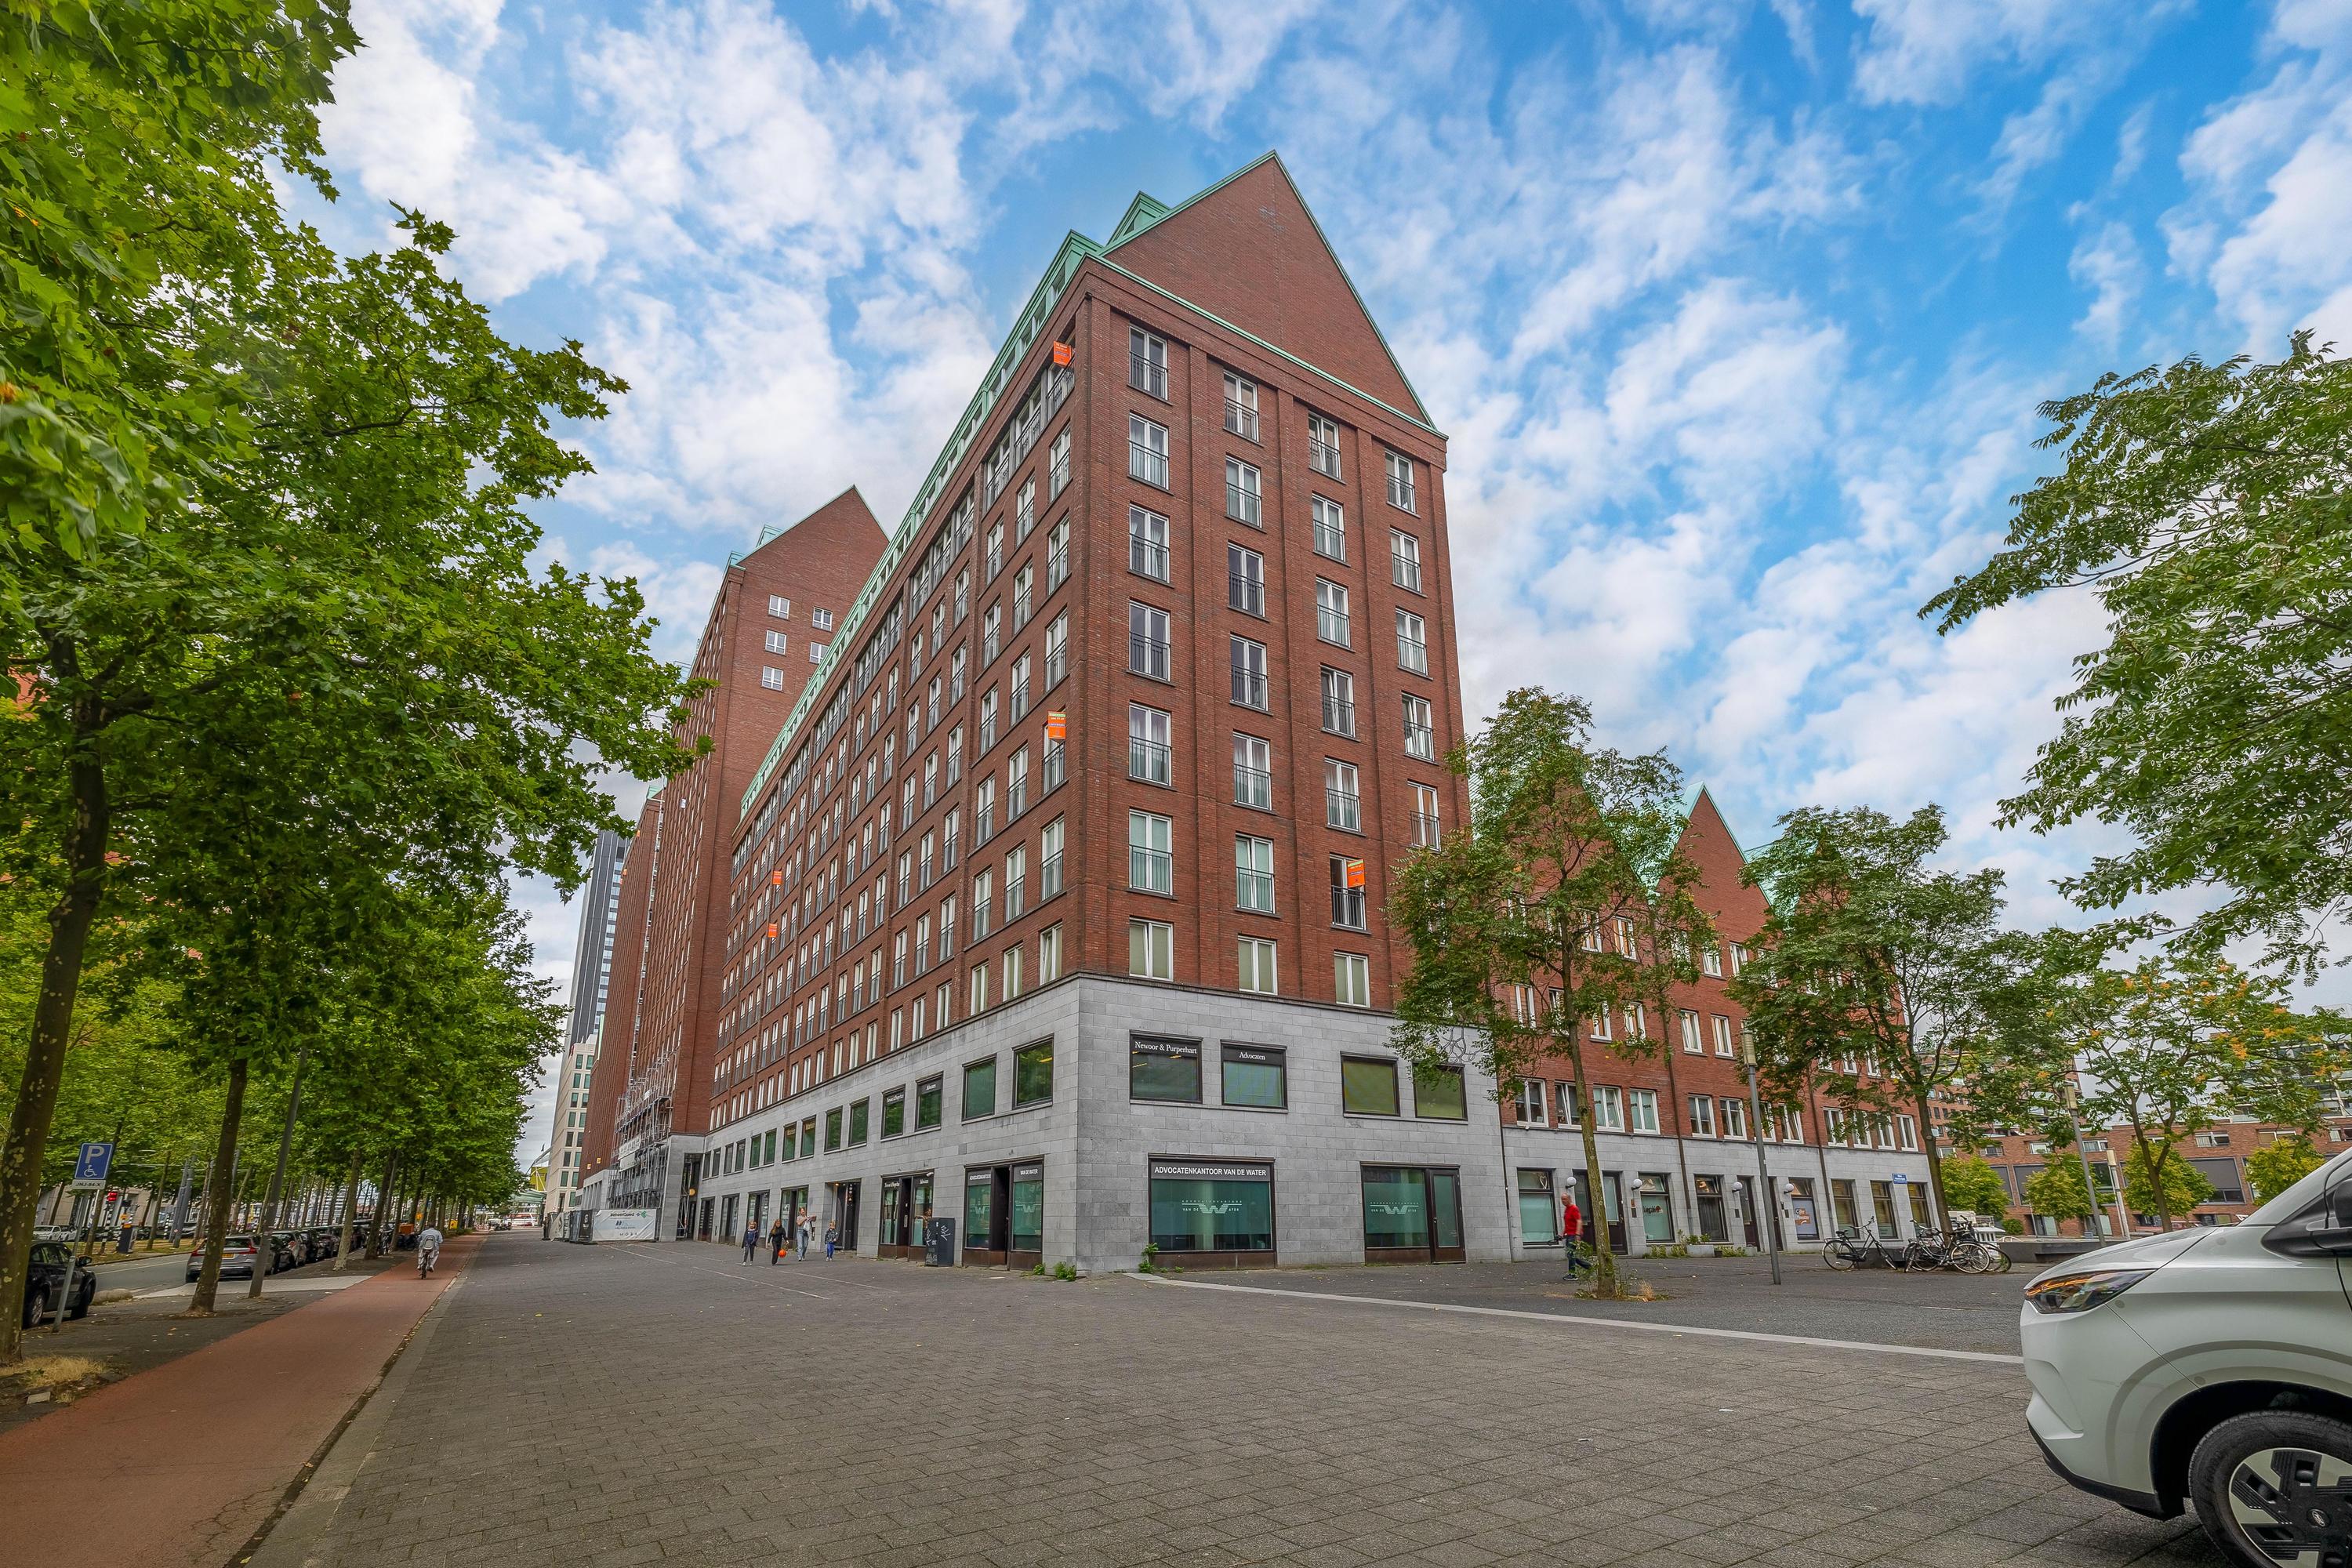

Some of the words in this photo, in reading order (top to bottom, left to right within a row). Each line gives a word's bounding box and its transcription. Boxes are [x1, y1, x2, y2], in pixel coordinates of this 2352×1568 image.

[1134, 1041, 1159, 1051] Newoor
[1166, 1044, 1197, 1054] Purperhart
[1239, 1051, 1266, 1060] Advocaten
[85, 1145, 105, 1163] P
[1154, 1167, 1223, 1175] ADVOCATENKANTOOR
